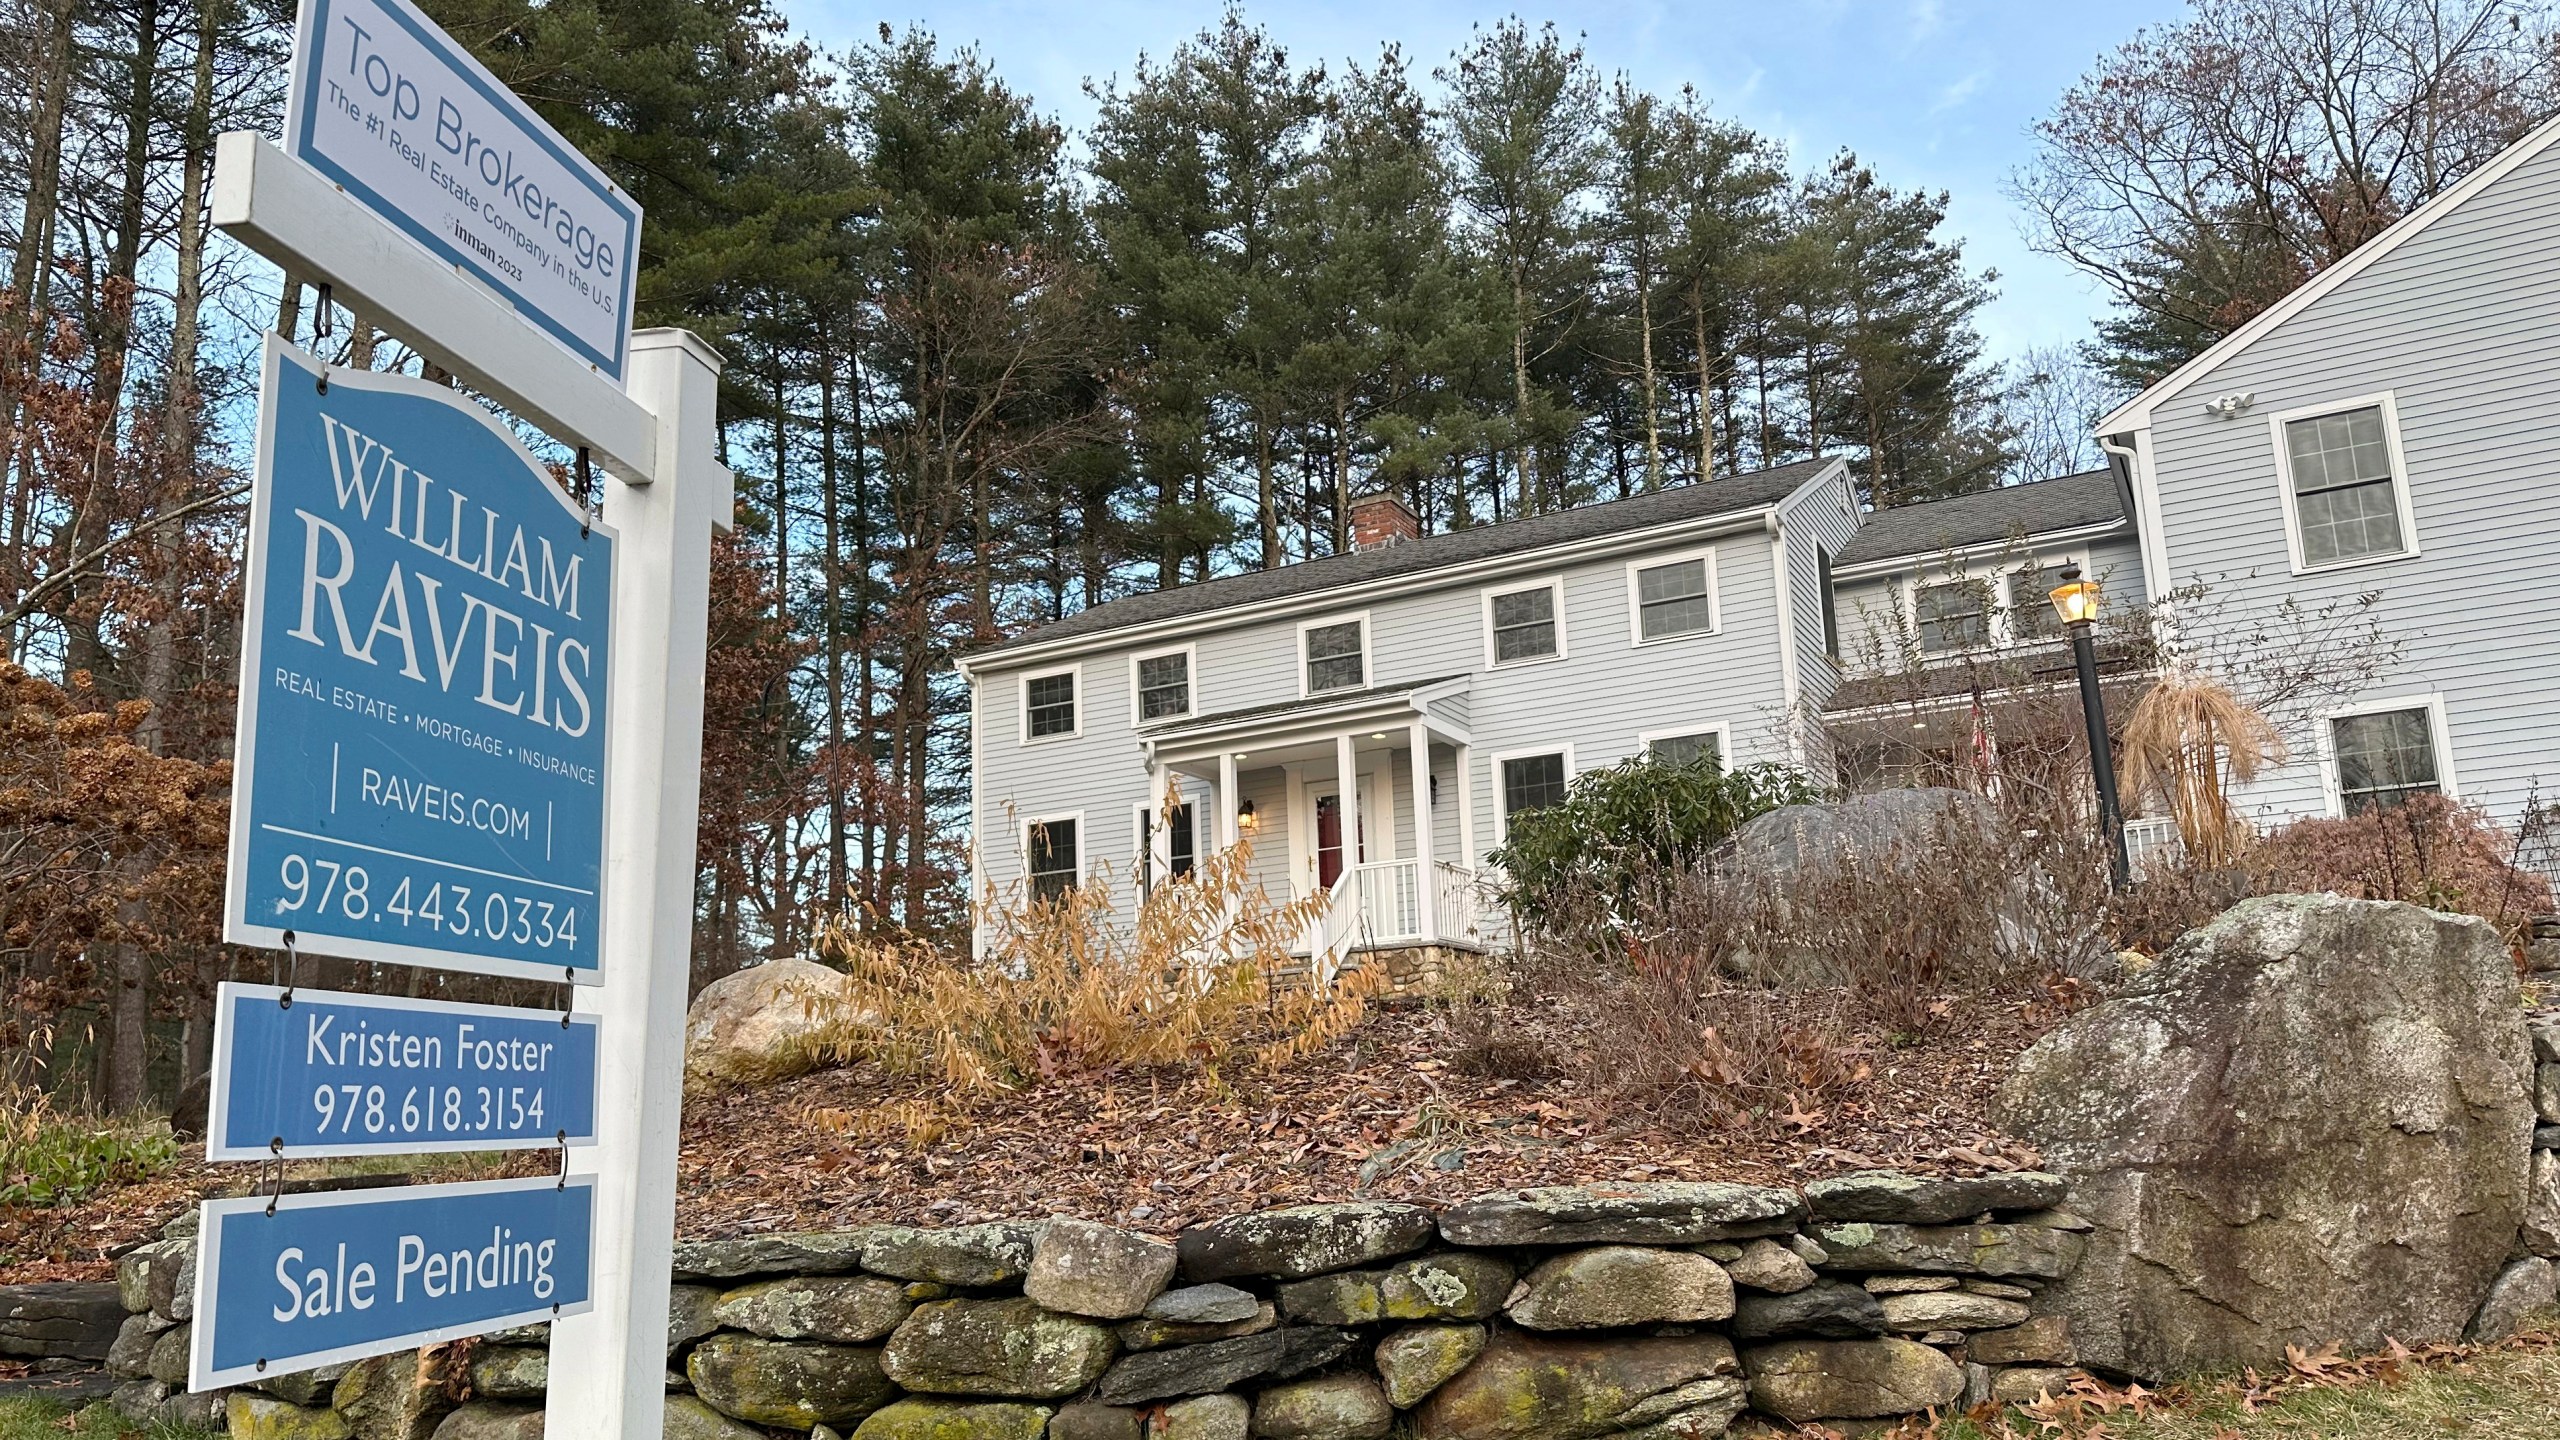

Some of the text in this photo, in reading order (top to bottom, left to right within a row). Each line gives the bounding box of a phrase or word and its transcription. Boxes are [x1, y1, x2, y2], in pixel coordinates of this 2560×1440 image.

[343, 16, 614, 278] Top Brokerage
[327, 79, 615, 317] The #1 Real Estate Company in the U.S.
[454, 219, 523, 282] inman 2023
[320, 413, 583, 620] WILLIAM
[287, 508, 591, 738] RAVEIS
[275, 668, 596, 785] REAL ESTATE MORTGAGE INSURANCE
[362, 768, 529, 840] RAVEIS.COM
[280, 853, 577, 951] 978.443.0334
[307, 1013, 553, 1071] Kristen Foster
[314, 1084, 544, 1134] 978.618.3154
[273, 1226, 556, 1322] Sale Pending
